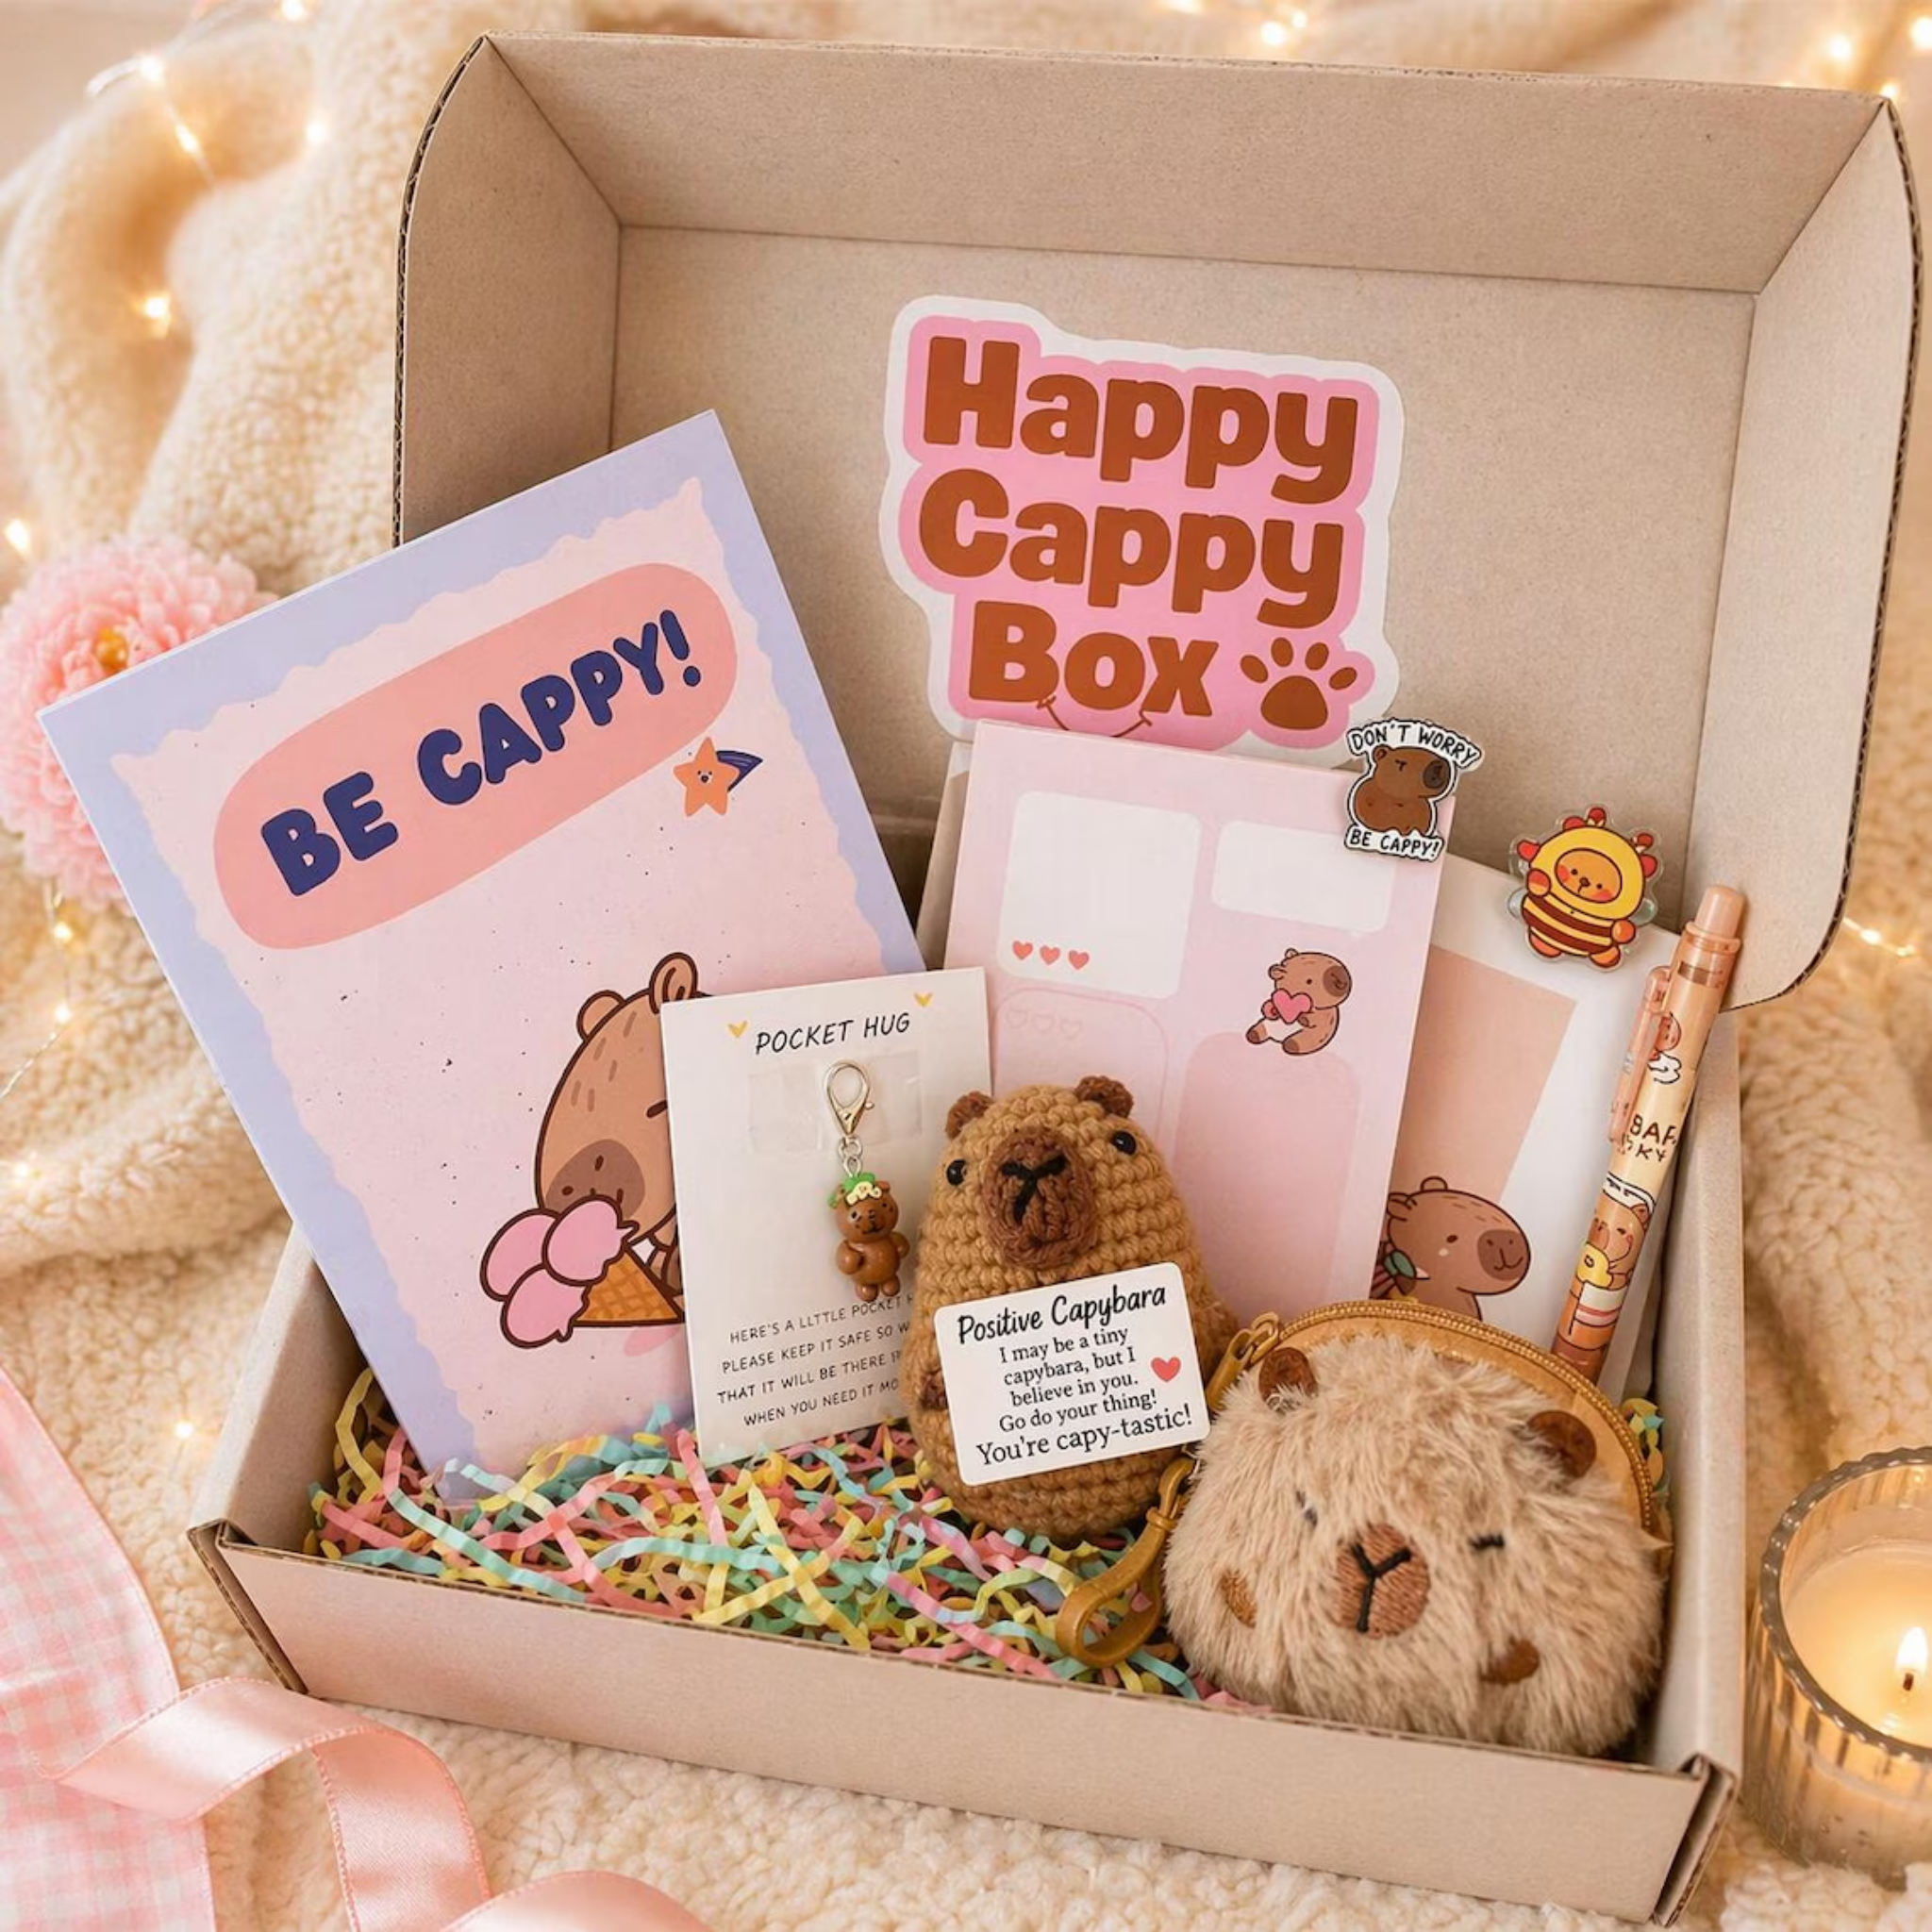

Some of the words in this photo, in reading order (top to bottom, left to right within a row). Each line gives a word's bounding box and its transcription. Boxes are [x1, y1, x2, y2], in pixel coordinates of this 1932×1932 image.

[923, 336, 1358, 505] Happy
[918, 468, 1343, 629] Cappy
[968, 600, 1220, 717] Box
[260, 771, 399, 897] BE
[417, 608, 702, 806] CAPPY!
[1352, 724, 1411, 751] DON'T
[1418, 726, 1476, 765] WORRY
[1350, 829, 1372, 846] BE
[1380, 835, 1440, 857] CAPPY!
[756, 1020, 854, 1055] POCKET
[863, 1012, 910, 1038] HUG
[729, 1322, 780, 1344] HERE'S
[784, 1320, 795, 1332] A
[852, 1296, 902, 1317] POCKET
[957, 1307, 1043, 1344] Positive
[1051, 1284, 1167, 1329] Capybara
[722, 1351, 775, 1374] PLEASE
[781, 1343, 815, 1360] KEEP
[821, 1338, 833, 1353] IT
[839, 1329, 872, 1348] SAFE
[877, 1324, 893, 1340] SO
[999, 1347, 1008, 1364] I
[1012, 1341, 1049, 1363] may
[1053, 1337, 1075, 1353] be
[1078, 1337, 1090, 1349] a
[1093, 1326, 1129, 1347] tiny
[1004, 1361, 1091, 1389] capybara,
[1092, 1352, 1124, 1371] but
[1127, 1346, 1137, 1363] I
[717, 1385, 756, 1404] THAT
[761, 1380, 775, 1394] IT
[780, 1373, 814, 1390] WILL
[820, 1365, 837, 1380] BE
[842, 1353, 887, 1374] THERE
[743, 1407, 786, 1427] WHEN
[791, 1398, 818, 1415] YOU
[823, 1389, 858, 1407] NEED
[862, 1383, 874, 1397] IT
[879, 1377, 899, 1393] MO
[1010, 1386, 1074, 1408] believe
[1078, 1379, 1097, 1396] in
[1101, 1373, 1140, 1394] you.
[976, 1435, 1052, 1466] You're
[1057, 1403, 1193, 1454] capy-tastic!
[999, 1414, 1026, 1434] Go
[1029, 1407, 1054, 1429] do
[1056, 1404, 1100, 1427] your
[1103, 1389, 1158, 1413] thing!
